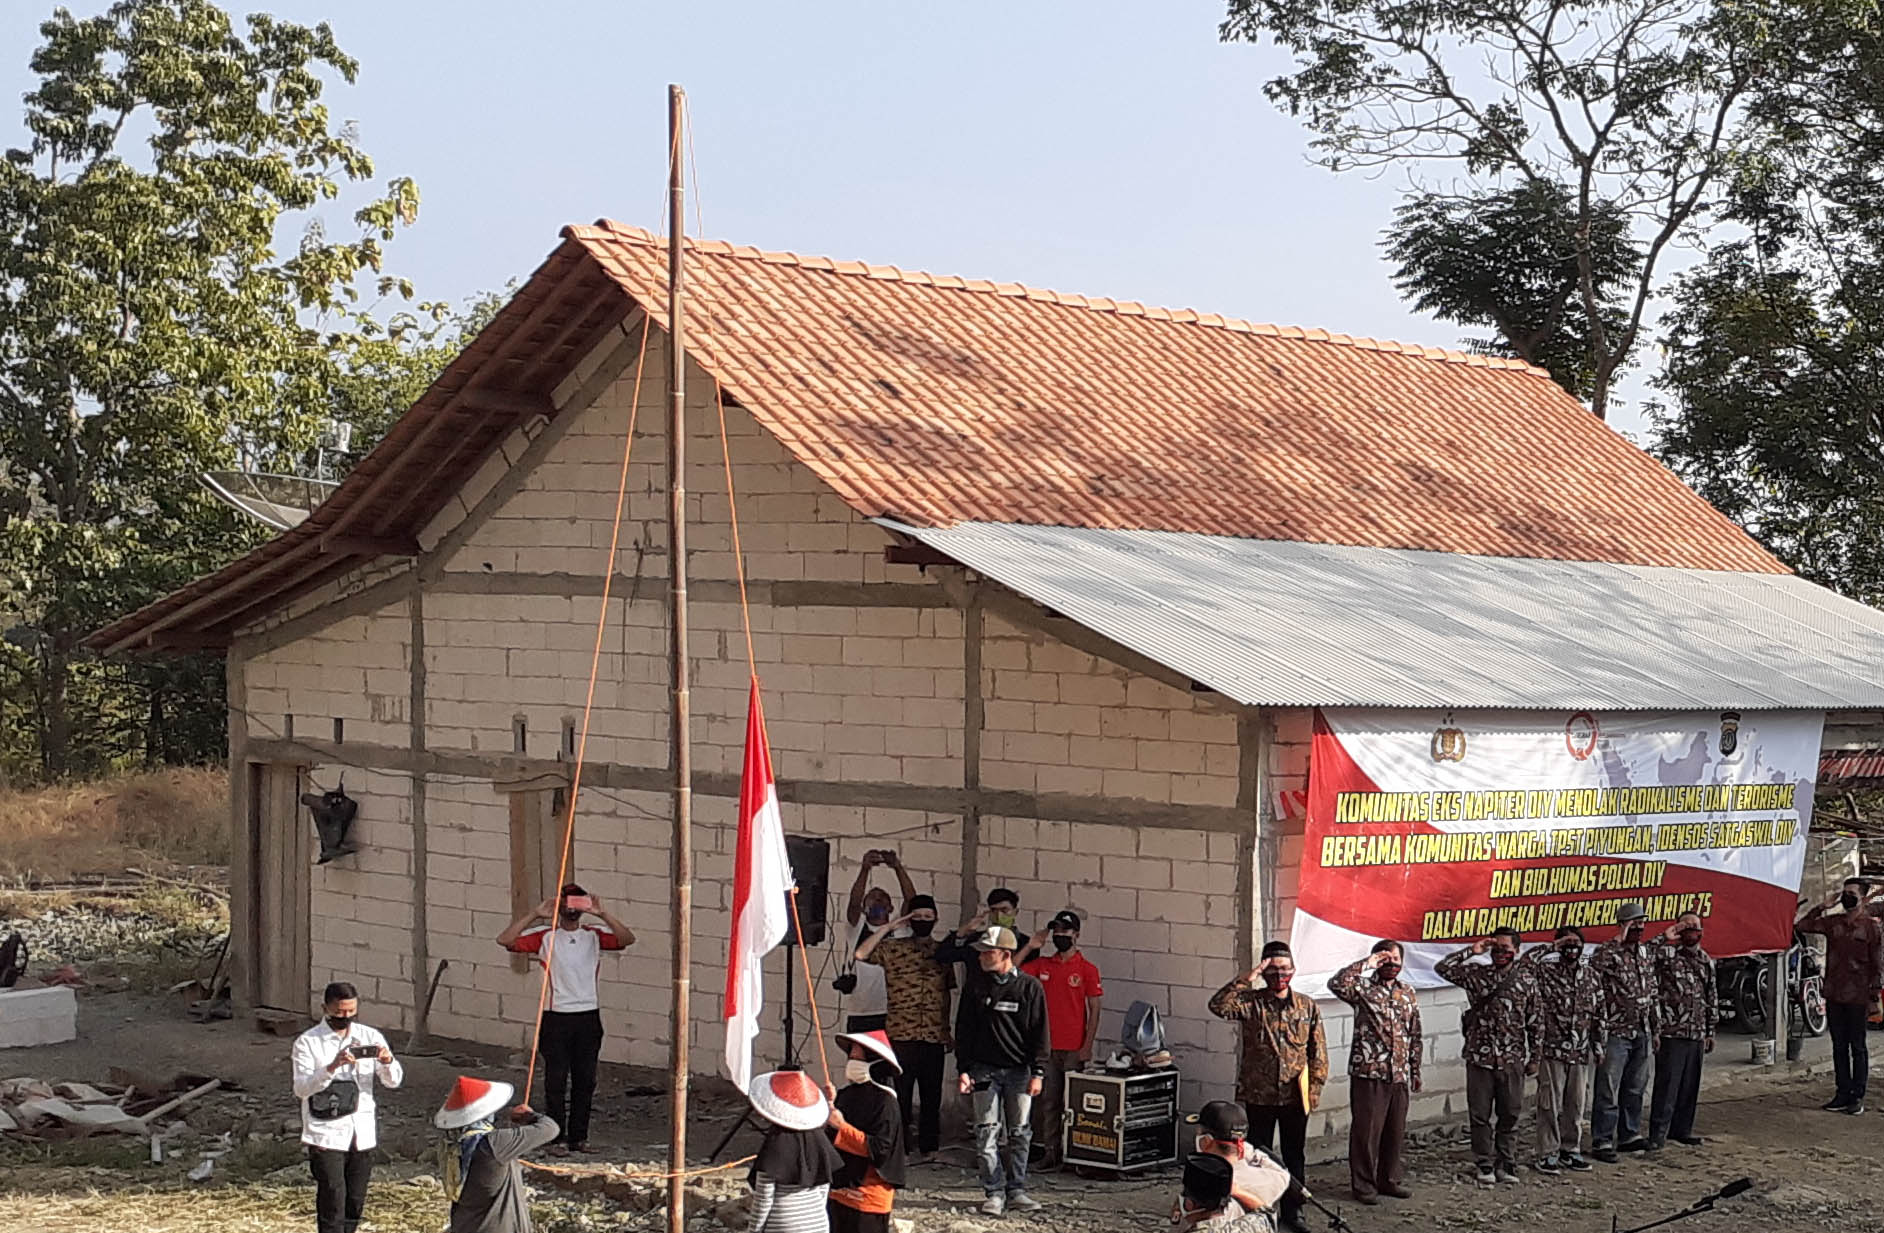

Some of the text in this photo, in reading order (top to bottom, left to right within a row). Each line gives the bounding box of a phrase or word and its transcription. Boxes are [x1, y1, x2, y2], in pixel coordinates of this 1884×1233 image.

[1335, 783, 1796, 823] KOMUNITAS EKS NAPITER DIY MENOLAK RADIKALISME DAN TERORISME
[1320, 819, 1797, 867] BERSAMA KOMUNITAS WARGA TPST PIYUNGAN, IDENSOS SATGASWIL DIY
[1489, 869, 1522, 899] DAN
[1549, 865, 1601, 895] HUMAS
[1600, 862, 1641, 891] POLDA
[1642, 860, 1667, 888] DIY
[1422, 908, 1478, 941] DALAM
[1477, 904, 1535, 936] RANGKA
[1536, 902, 1566, 932] HUT
[1663, 895, 1679, 920] RI
[1696, 891, 1714, 918] 75
